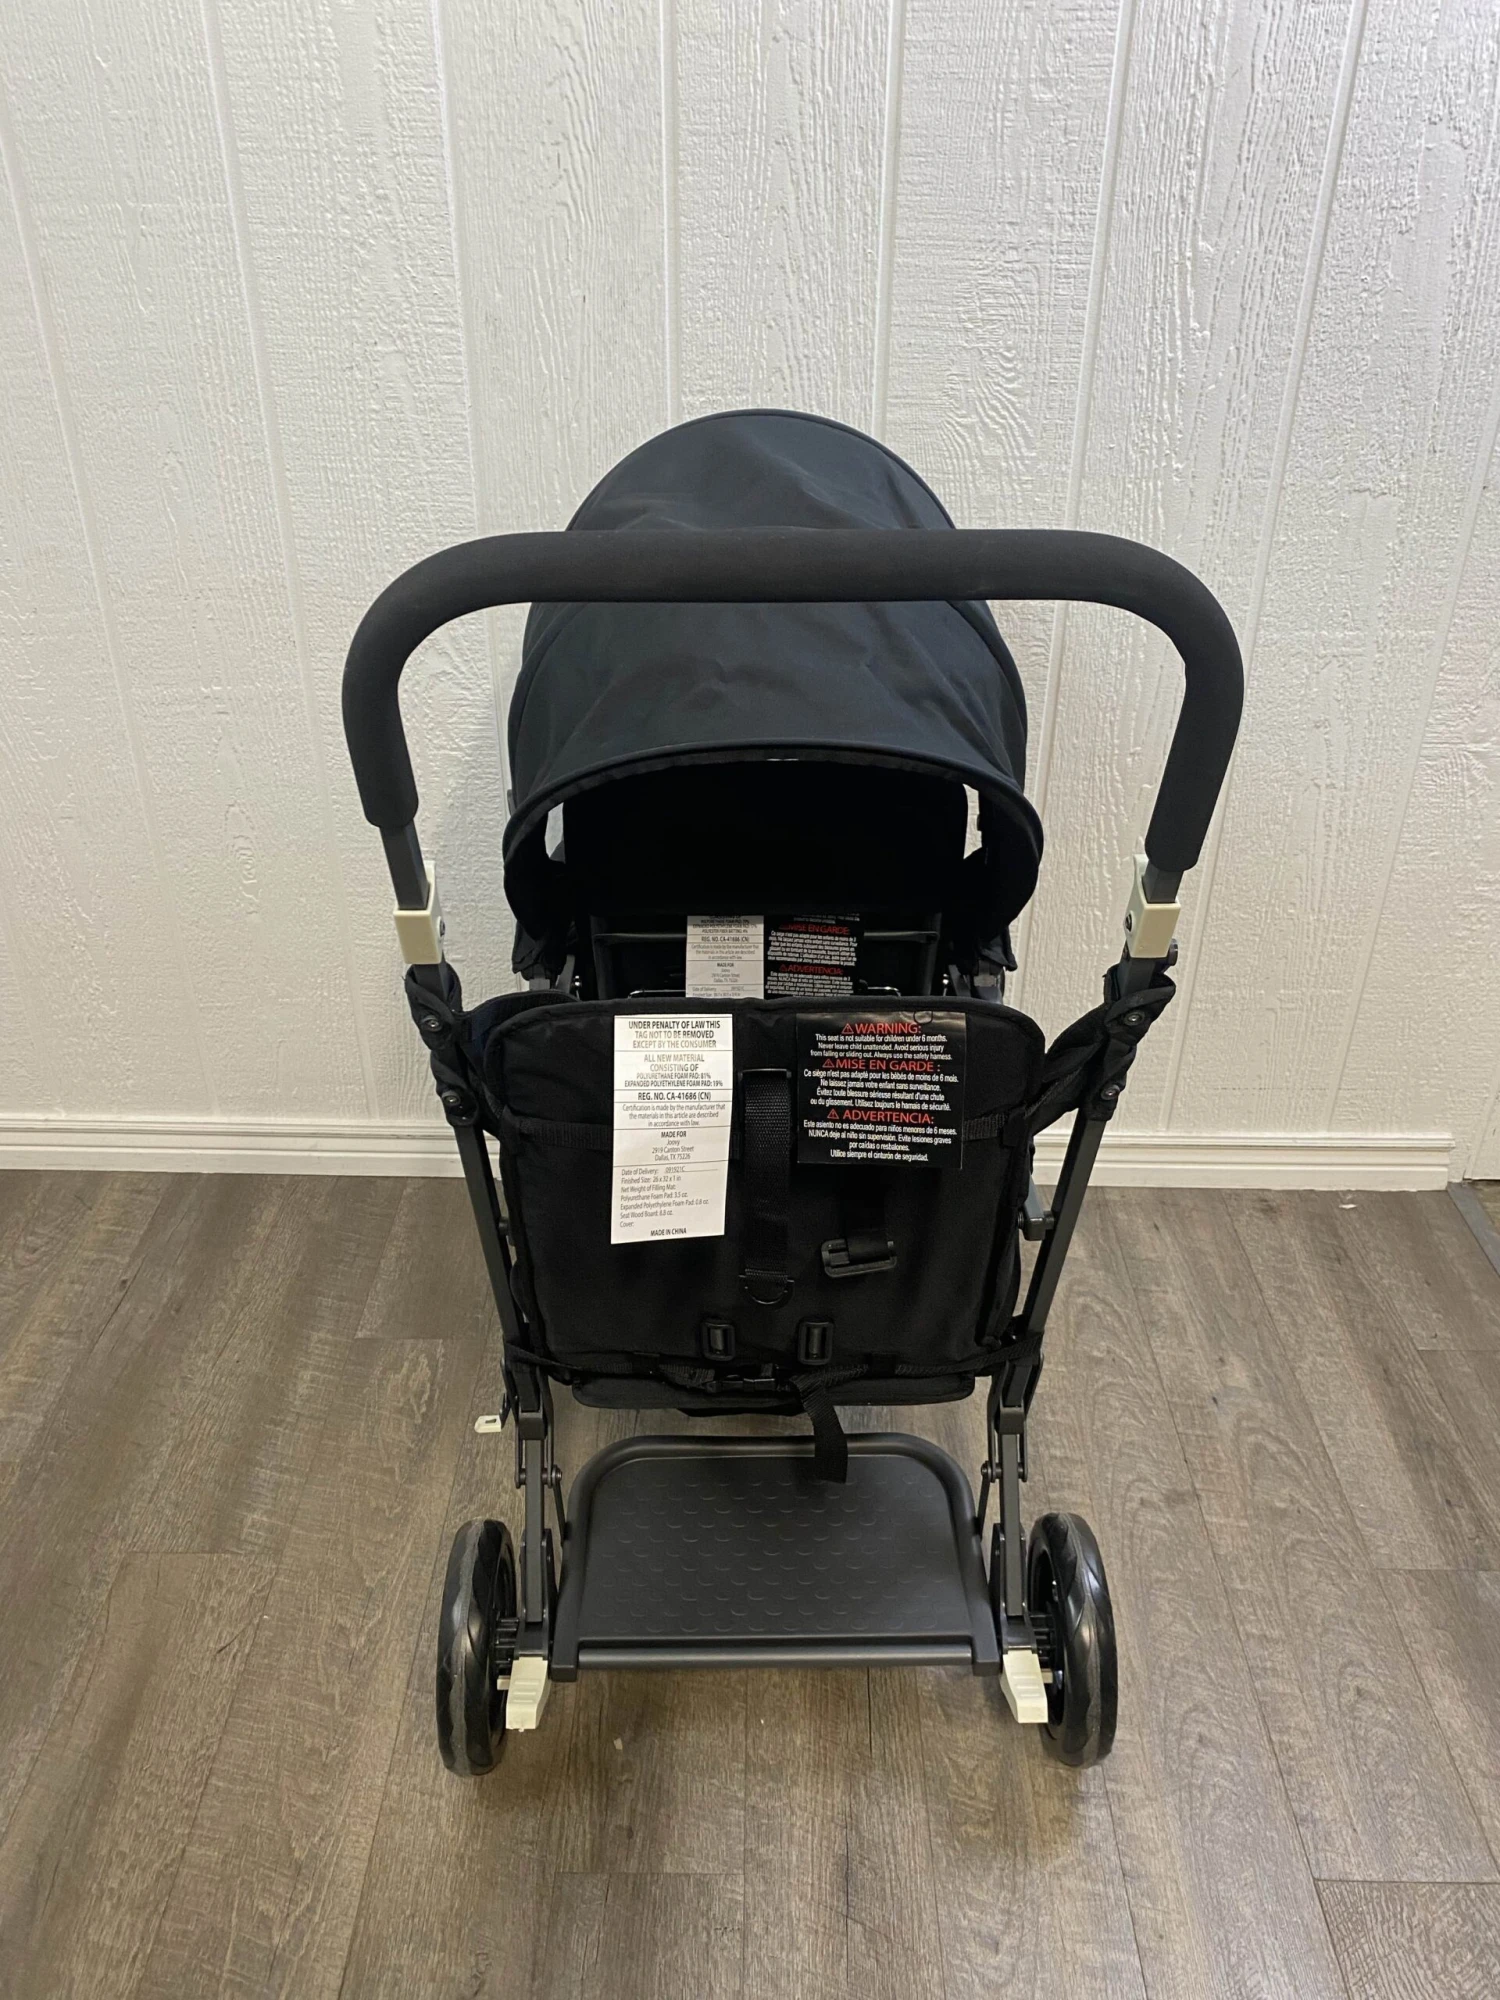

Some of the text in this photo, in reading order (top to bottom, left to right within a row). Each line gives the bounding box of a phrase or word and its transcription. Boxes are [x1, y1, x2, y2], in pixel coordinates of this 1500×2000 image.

[855, 1024, 921, 1033] WARNING:
[836, 1060, 934, 1071] MISE EN GARDE
[851, 1071, 868, 1080] adapté
[847, 1081, 864, 1089] jamais
[698, 1092, 711, 1100] (CN)
[843, 1110, 934, 1124] ADVERTENCIA:
[850, 1123, 874, 1131] adecuado
[829, 1131, 840, 1139] deje
[867, 1133, 897, 1142] supervisión.
[847, 1150, 867, 1160] siempre
[902, 1153, 928, 1162] seguridad.
